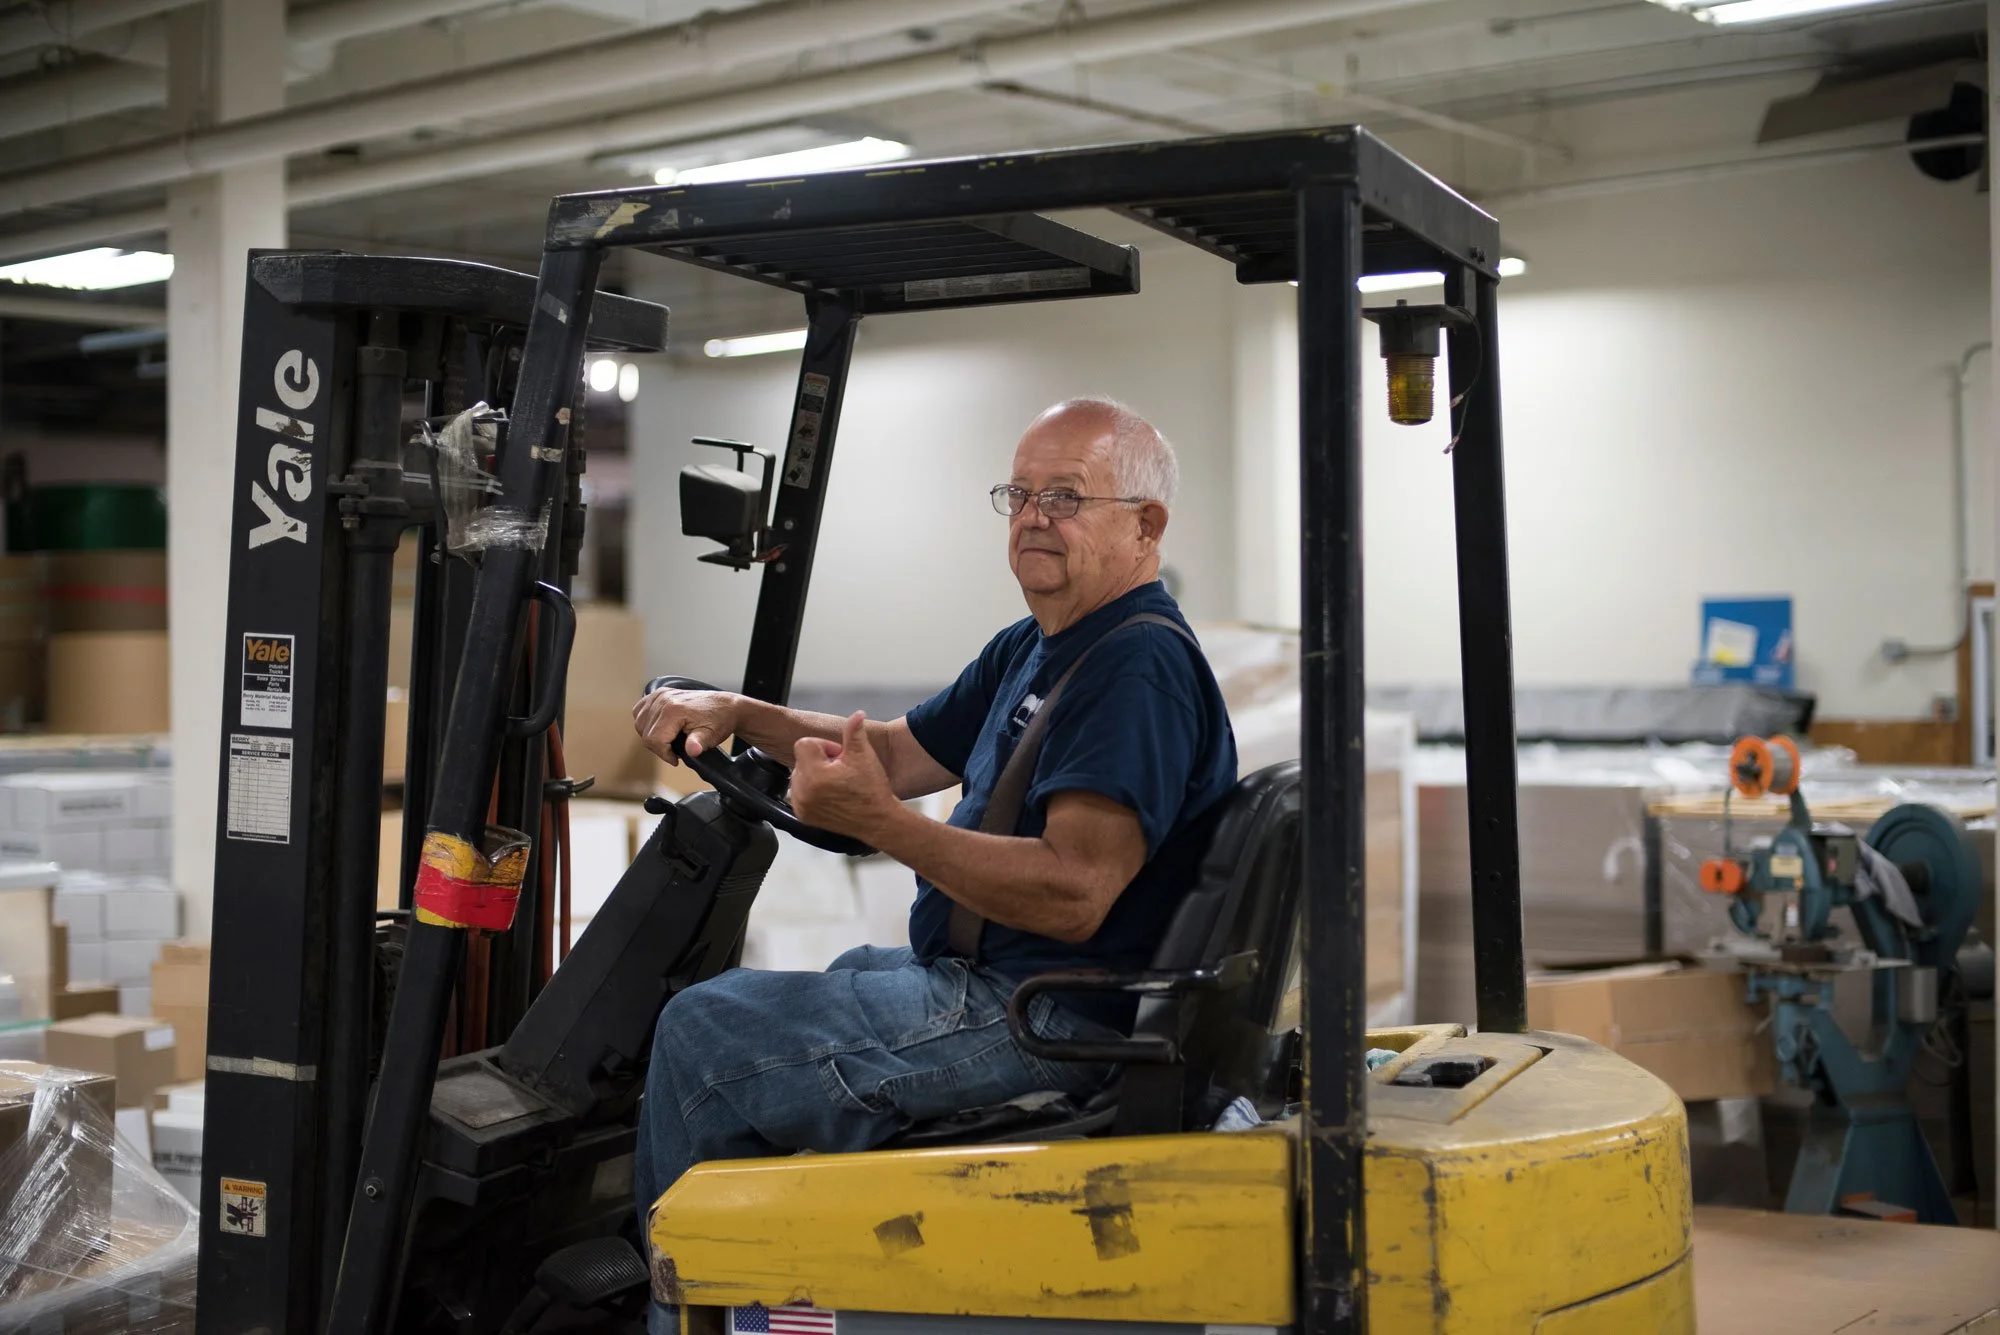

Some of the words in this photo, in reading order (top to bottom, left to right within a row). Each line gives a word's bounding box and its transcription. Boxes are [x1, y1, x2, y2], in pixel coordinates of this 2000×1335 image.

[249, 350, 319, 549] Yale
[247, 639, 290, 662] Yale
[232, 1184, 263, 1195] WARNING
